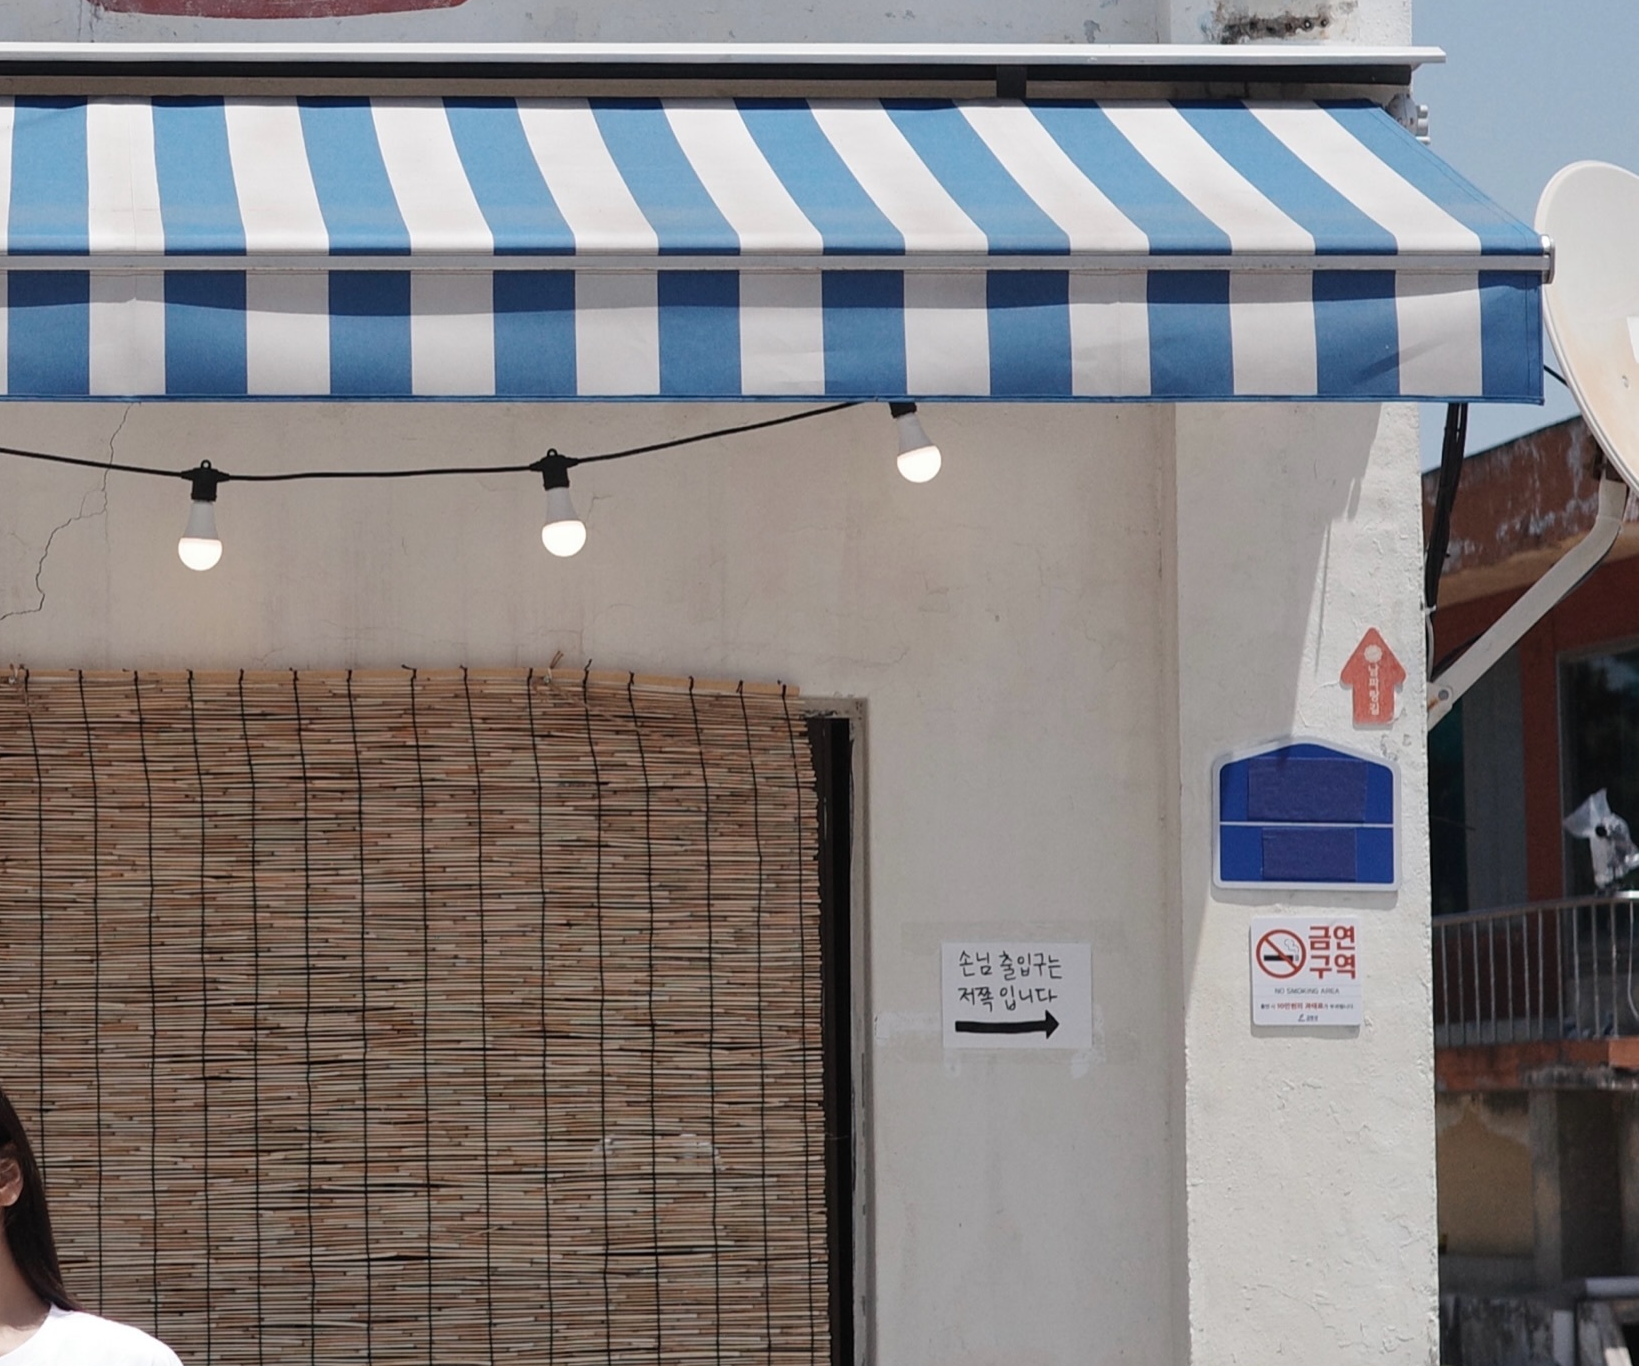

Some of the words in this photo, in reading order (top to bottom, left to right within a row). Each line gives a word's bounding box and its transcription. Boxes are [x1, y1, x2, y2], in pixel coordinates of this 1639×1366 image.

[1308, 925, 1356, 950] 금연
[959, 950, 993, 977] 손님
[998, 950, 1063, 981] 출입구는
[1308, 952, 1356, 980] 구역
